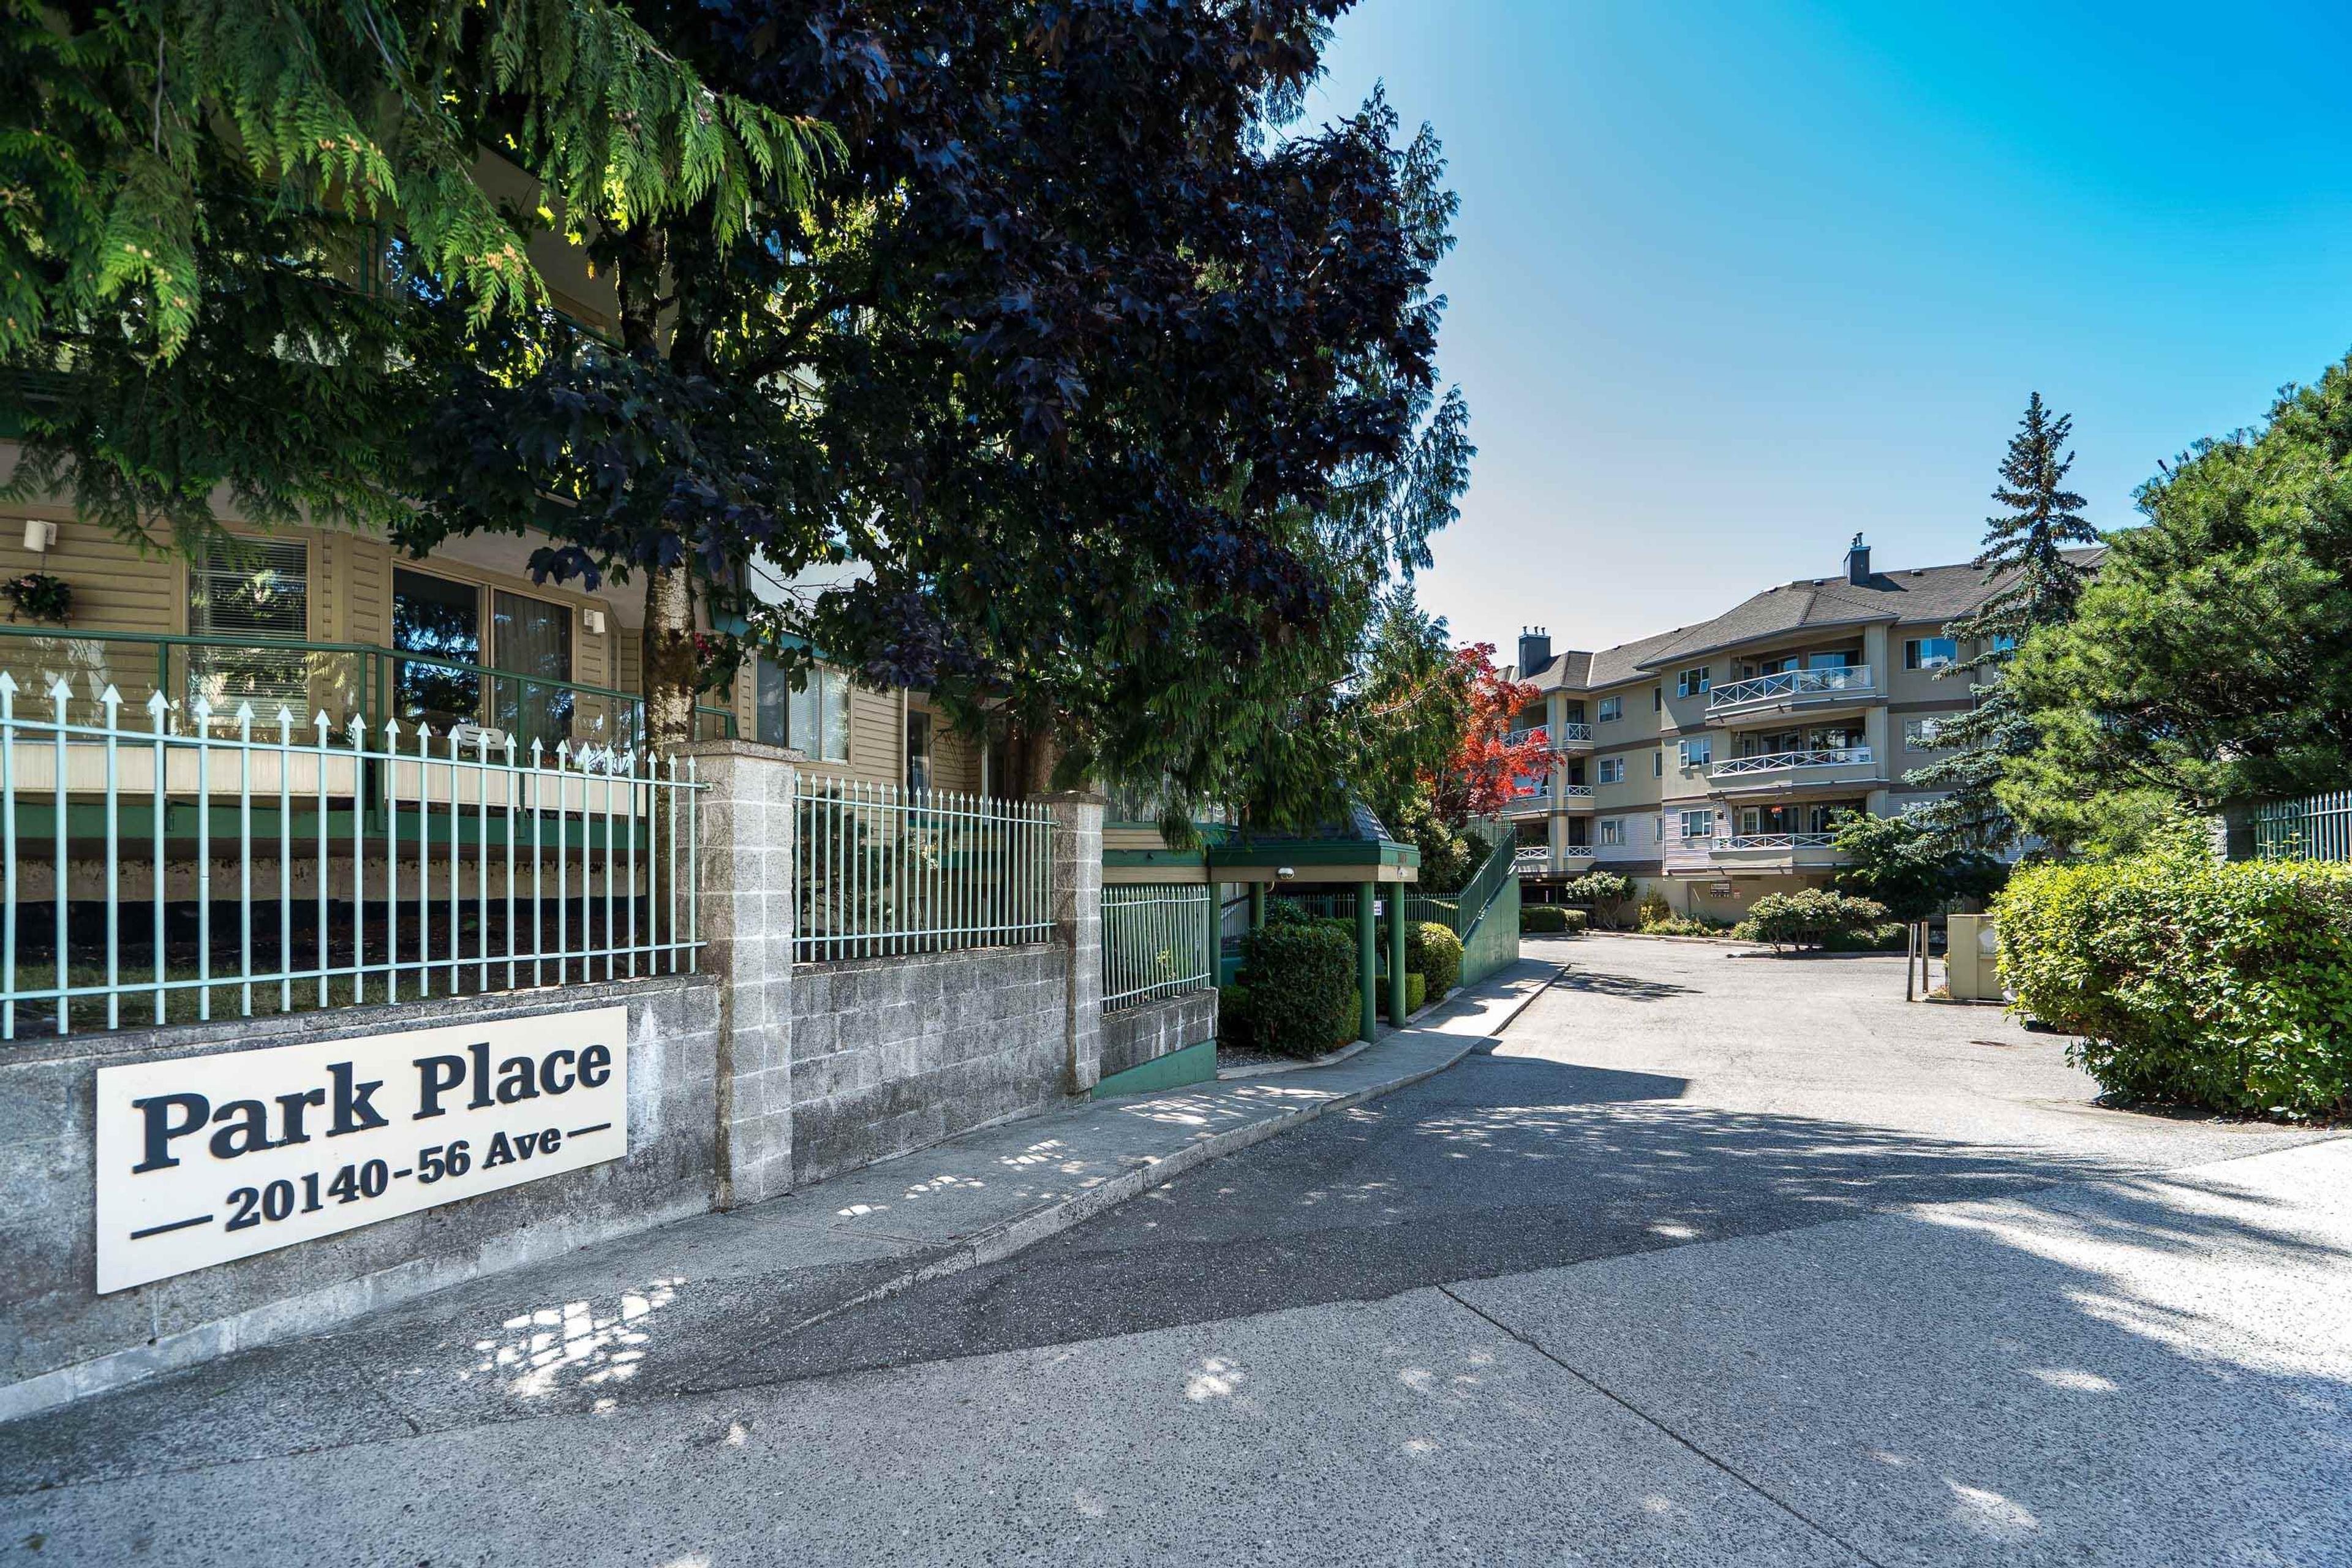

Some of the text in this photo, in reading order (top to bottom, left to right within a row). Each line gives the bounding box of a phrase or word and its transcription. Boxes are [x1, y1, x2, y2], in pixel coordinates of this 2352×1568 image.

[132, 1042, 611, 1175] Park Place
[225, 1128, 561, 1232] 20140-56 Ave
